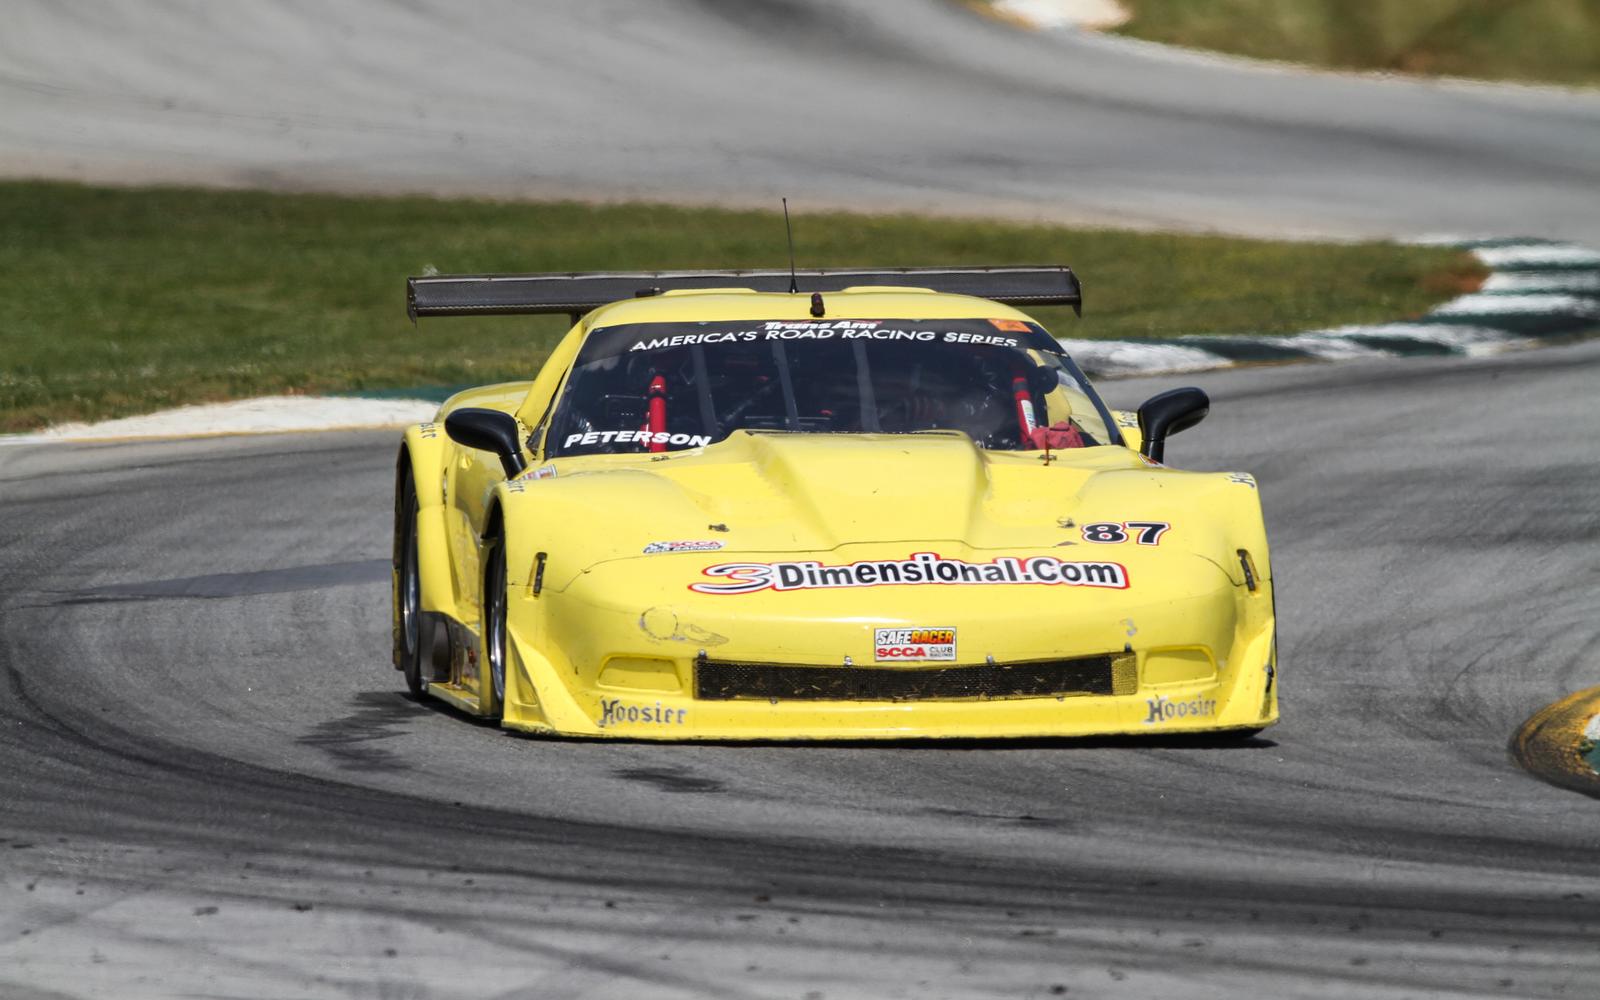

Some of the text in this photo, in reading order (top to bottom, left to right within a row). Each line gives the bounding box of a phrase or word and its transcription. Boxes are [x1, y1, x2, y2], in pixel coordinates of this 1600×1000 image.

[763, 320, 878, 330] Trans Am
[629, 329, 1019, 352] AMERICA'S ROAD RACING SERIES
[563, 430, 713, 449] PETERSON
[1081, 521, 1171, 546] 87
[876, 646, 927, 658] SCCA
[598, 699, 686, 725] Hoosier
